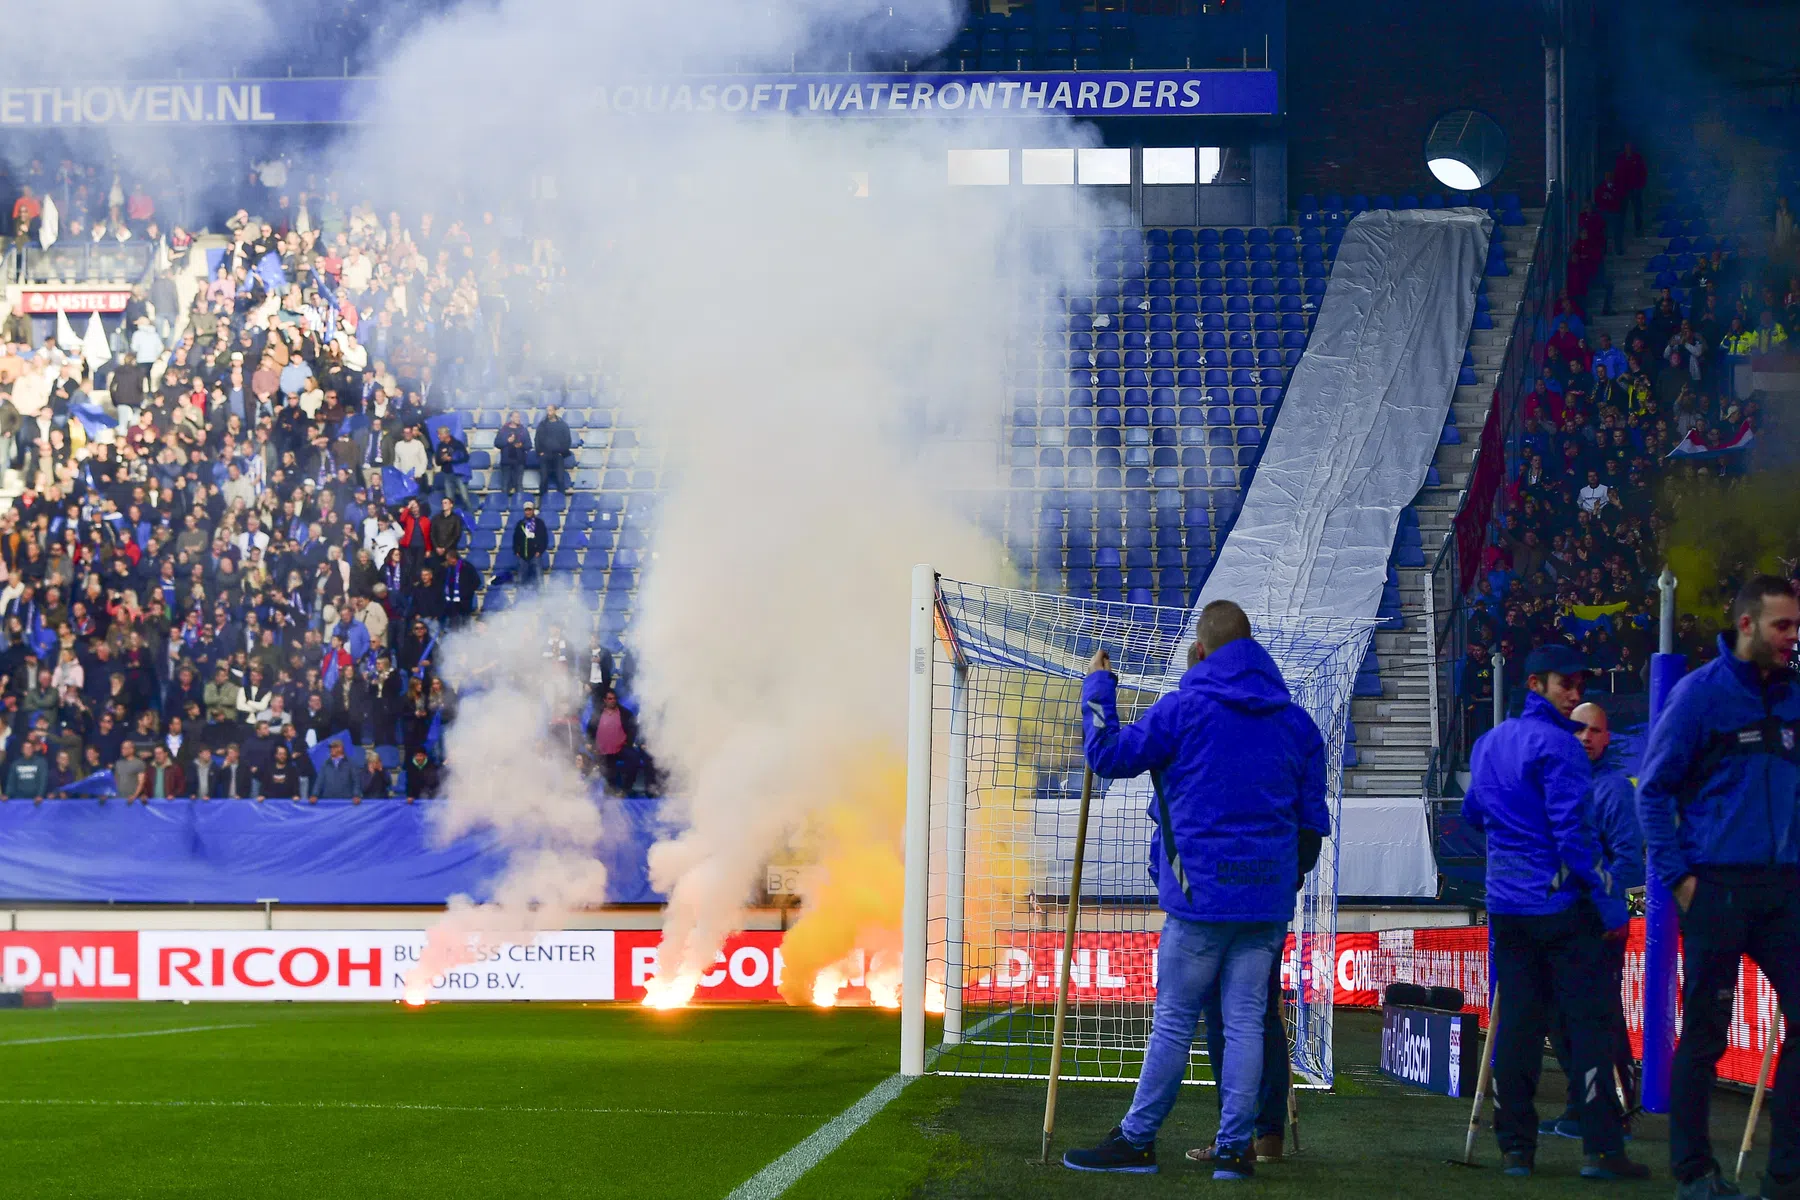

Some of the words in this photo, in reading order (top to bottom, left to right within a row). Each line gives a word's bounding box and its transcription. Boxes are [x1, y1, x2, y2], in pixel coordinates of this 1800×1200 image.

[1, 85, 276, 123] ETHOVEN.NL
[594, 83, 797, 116] AQUASOFT
[806, 78, 1201, 112] WATERONTHARDERS
[45, 293, 106, 310] AMSTEL
[108, 293, 131, 310] BI
[2, 945, 131, 987] D.NL
[158, 946, 382, 987] RICOH
[508, 944, 596, 962] CENTER
[393, 973, 479, 989] NORD
[486, 973, 525, 989] B.V.
